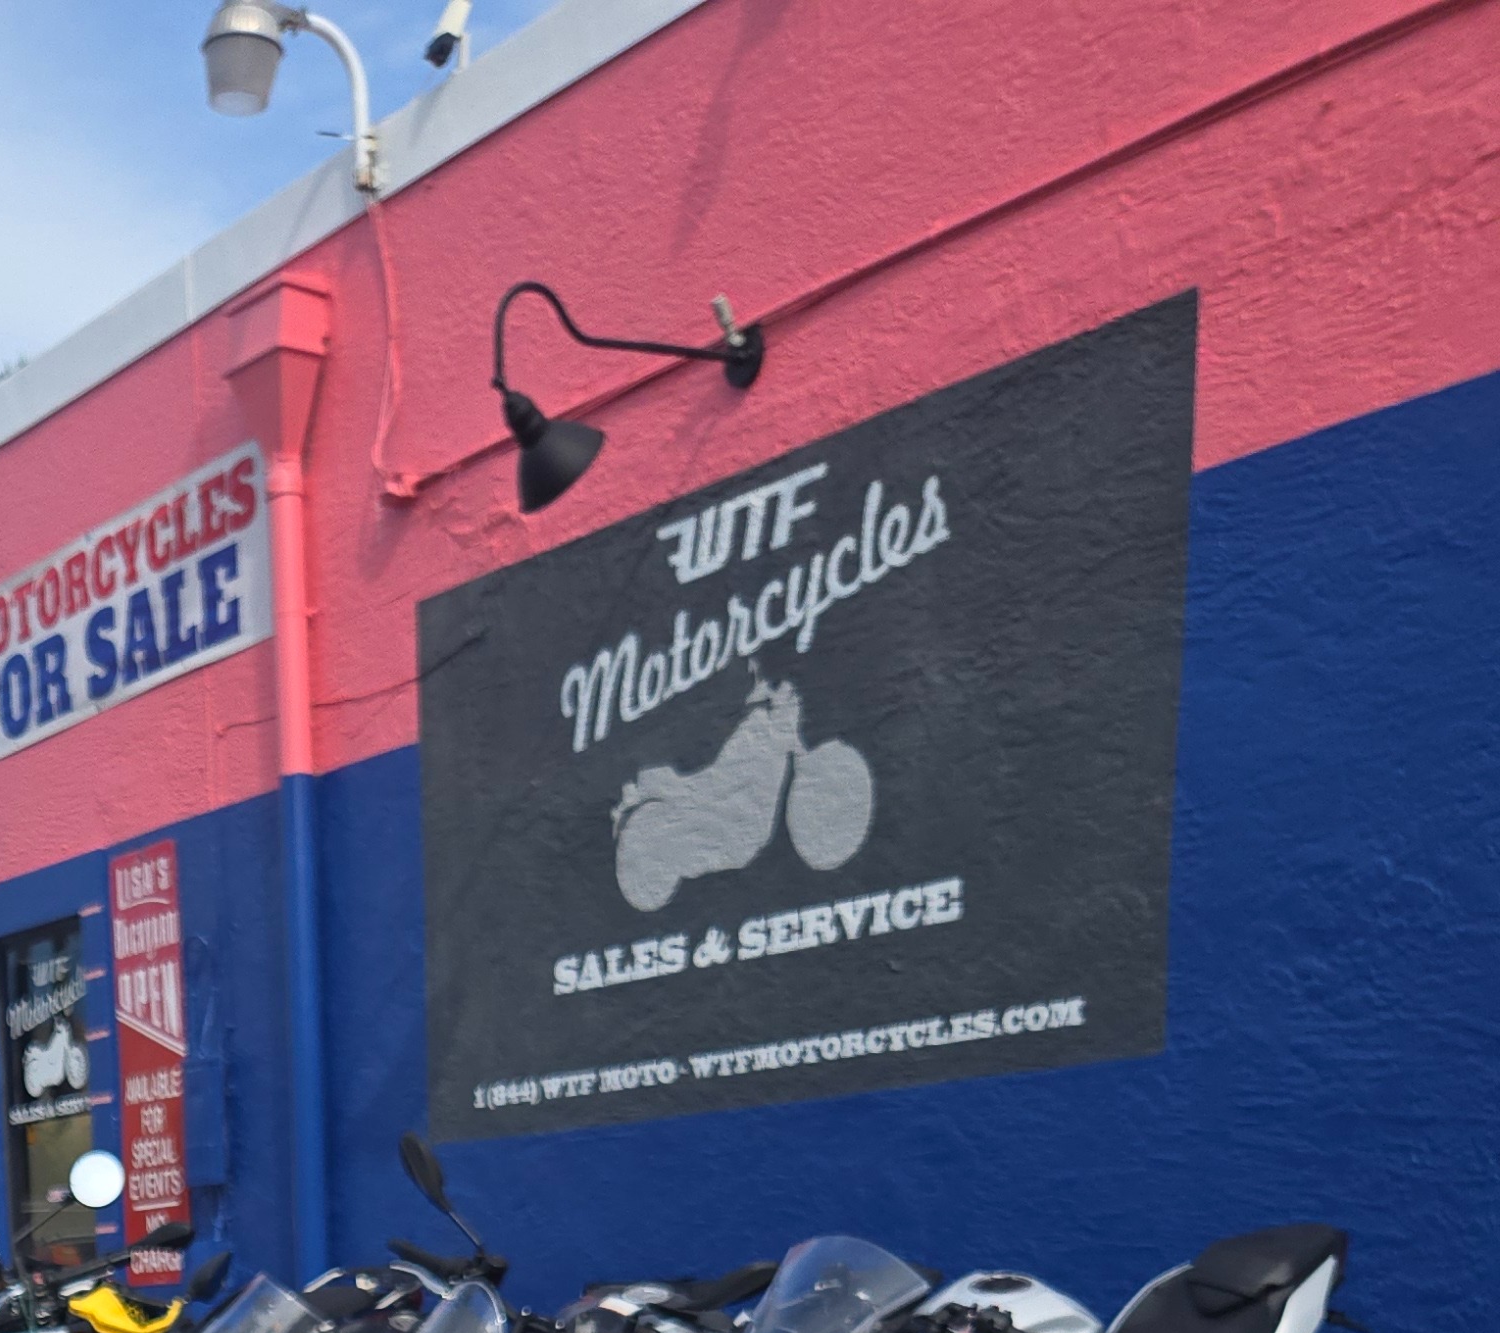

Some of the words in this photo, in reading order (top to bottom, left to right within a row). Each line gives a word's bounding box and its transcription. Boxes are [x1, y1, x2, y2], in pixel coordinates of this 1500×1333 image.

[656, 462, 829, 584] WTF
[85, 543, 242, 701] SALE
[560, 474, 951, 754] Motorcycles
[553, 933, 690, 996] SALES
[693, 926, 734, 968] &
[737, 877, 966, 961] SERVICE
[117, 960, 180, 1042] OPEN
[540, 1070, 597, 1100] WTF
[598, 1059, 678, 1093] MOTO
[687, 995, 1087, 1080] WTFMOTORCYCLES.COM
[131, 1137, 178, 1169] SPECIAL
[140, 1102, 166, 1134] FOR
[129, 1167, 183, 1200] EVENTS
